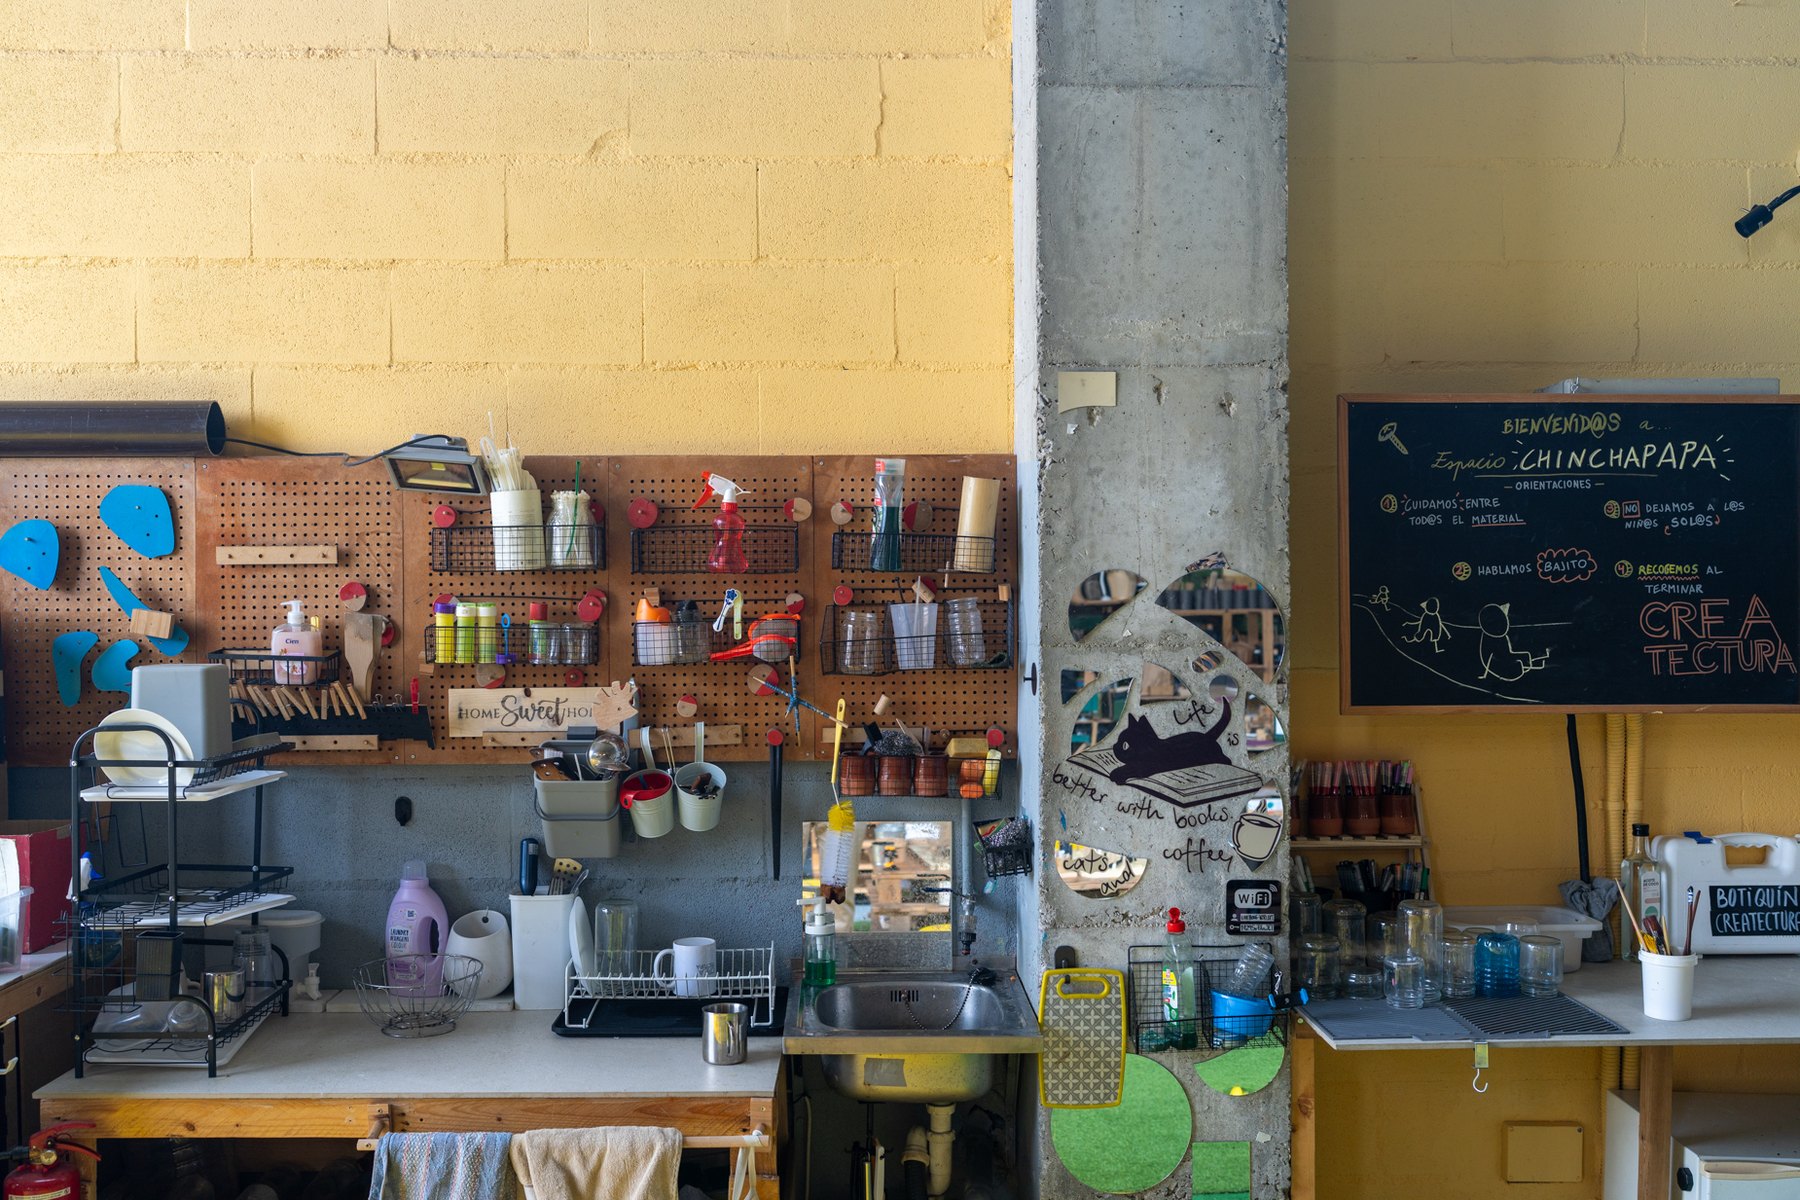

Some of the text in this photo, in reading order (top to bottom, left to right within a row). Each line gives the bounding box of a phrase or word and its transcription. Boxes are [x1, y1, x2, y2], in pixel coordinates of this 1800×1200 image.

[1502, 412, 1621, 439] BIENVENID@S
[1431, 441, 1717, 481] Espacio CHINCHAPAPA
[1515, 479, 1592, 491] ORIENTACIONES
[1404, 498, 1458, 512] CUIDAMOS
[1465, 497, 1501, 509] ENTRE
[1624, 504, 1638, 514] NO
[1646, 502, 1695, 513] DEJAMOS
[1706, 504, 1715, 512] A
[1724, 501, 1746, 511] L@S
[1409, 513, 1525, 526] TOD@S EL MATERIAL
[1670, 514, 1714, 529] SOL@S
[1477, 563, 1533, 577] HABLAMOS
[1543, 559, 1588, 573] BAJITO
[1638, 563, 1699, 576] RECOGEMOS
[1706, 565, 1724, 575] AL
[1644, 583, 1704, 595] TERMINAR
[1643, 639, 1798, 676] TECTURA
[457, 694, 593, 727] HOME Sweet HO
[1227, 732, 1240, 747] is
[1052, 764, 1108, 804] better
[1117, 799, 1164, 820] with
[1101, 860, 1135, 895] and
[1238, 893, 1268, 904] WiFi
